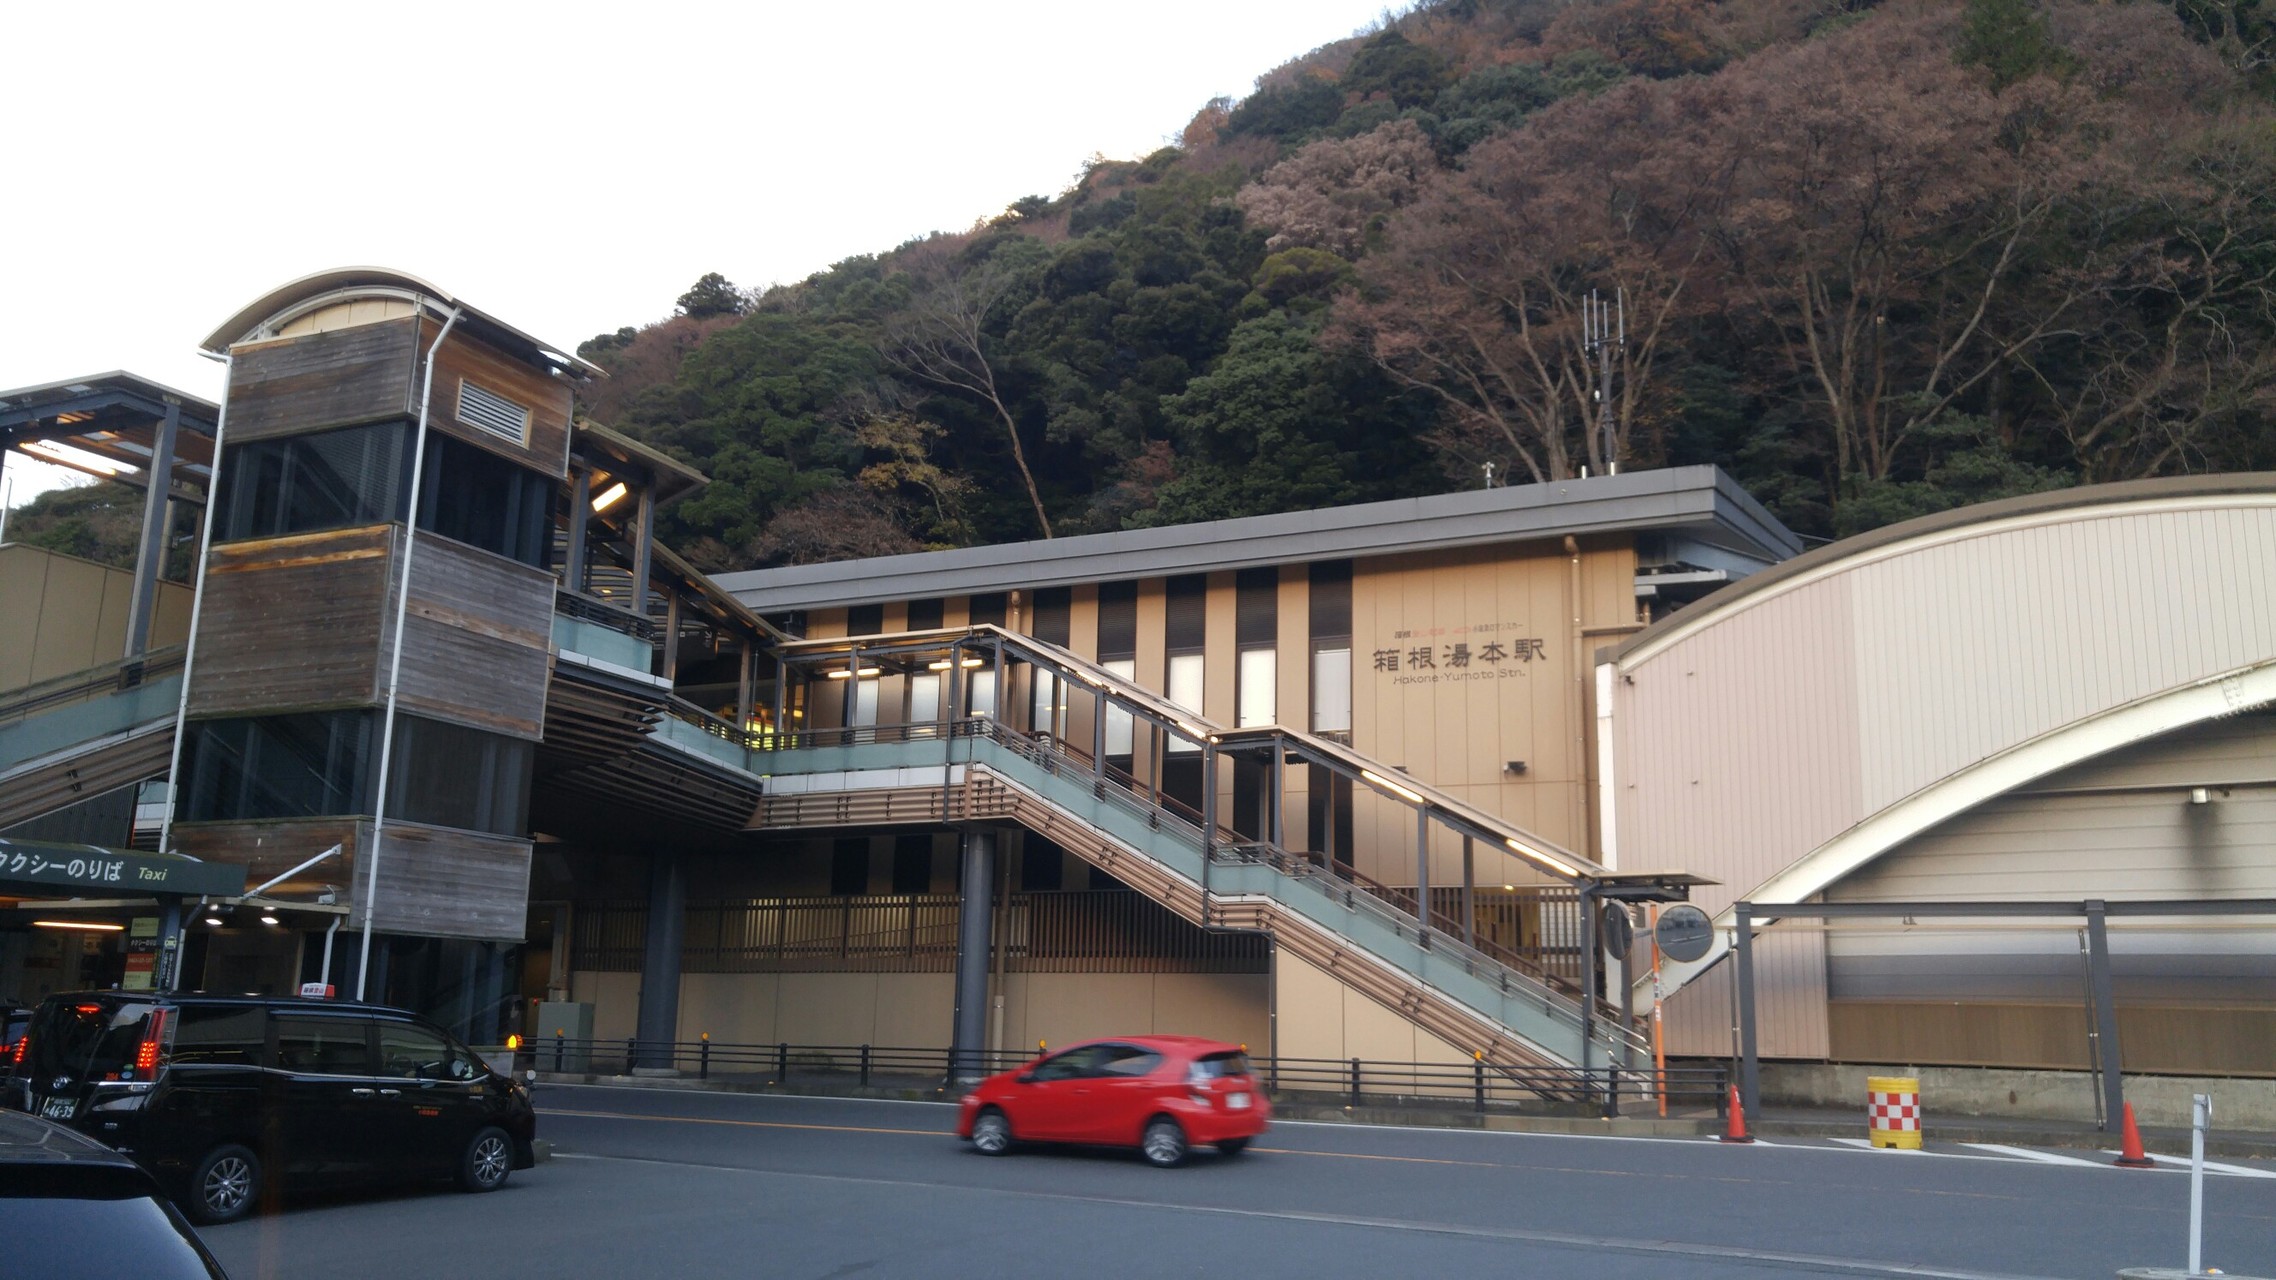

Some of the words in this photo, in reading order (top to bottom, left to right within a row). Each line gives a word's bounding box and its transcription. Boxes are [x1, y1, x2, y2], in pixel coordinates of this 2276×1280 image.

[1373, 638, 1547, 672] 箱根湯本駅
[1500, 668, 1526, 679] Stn.
[138, 867, 168, 881] Taxi
